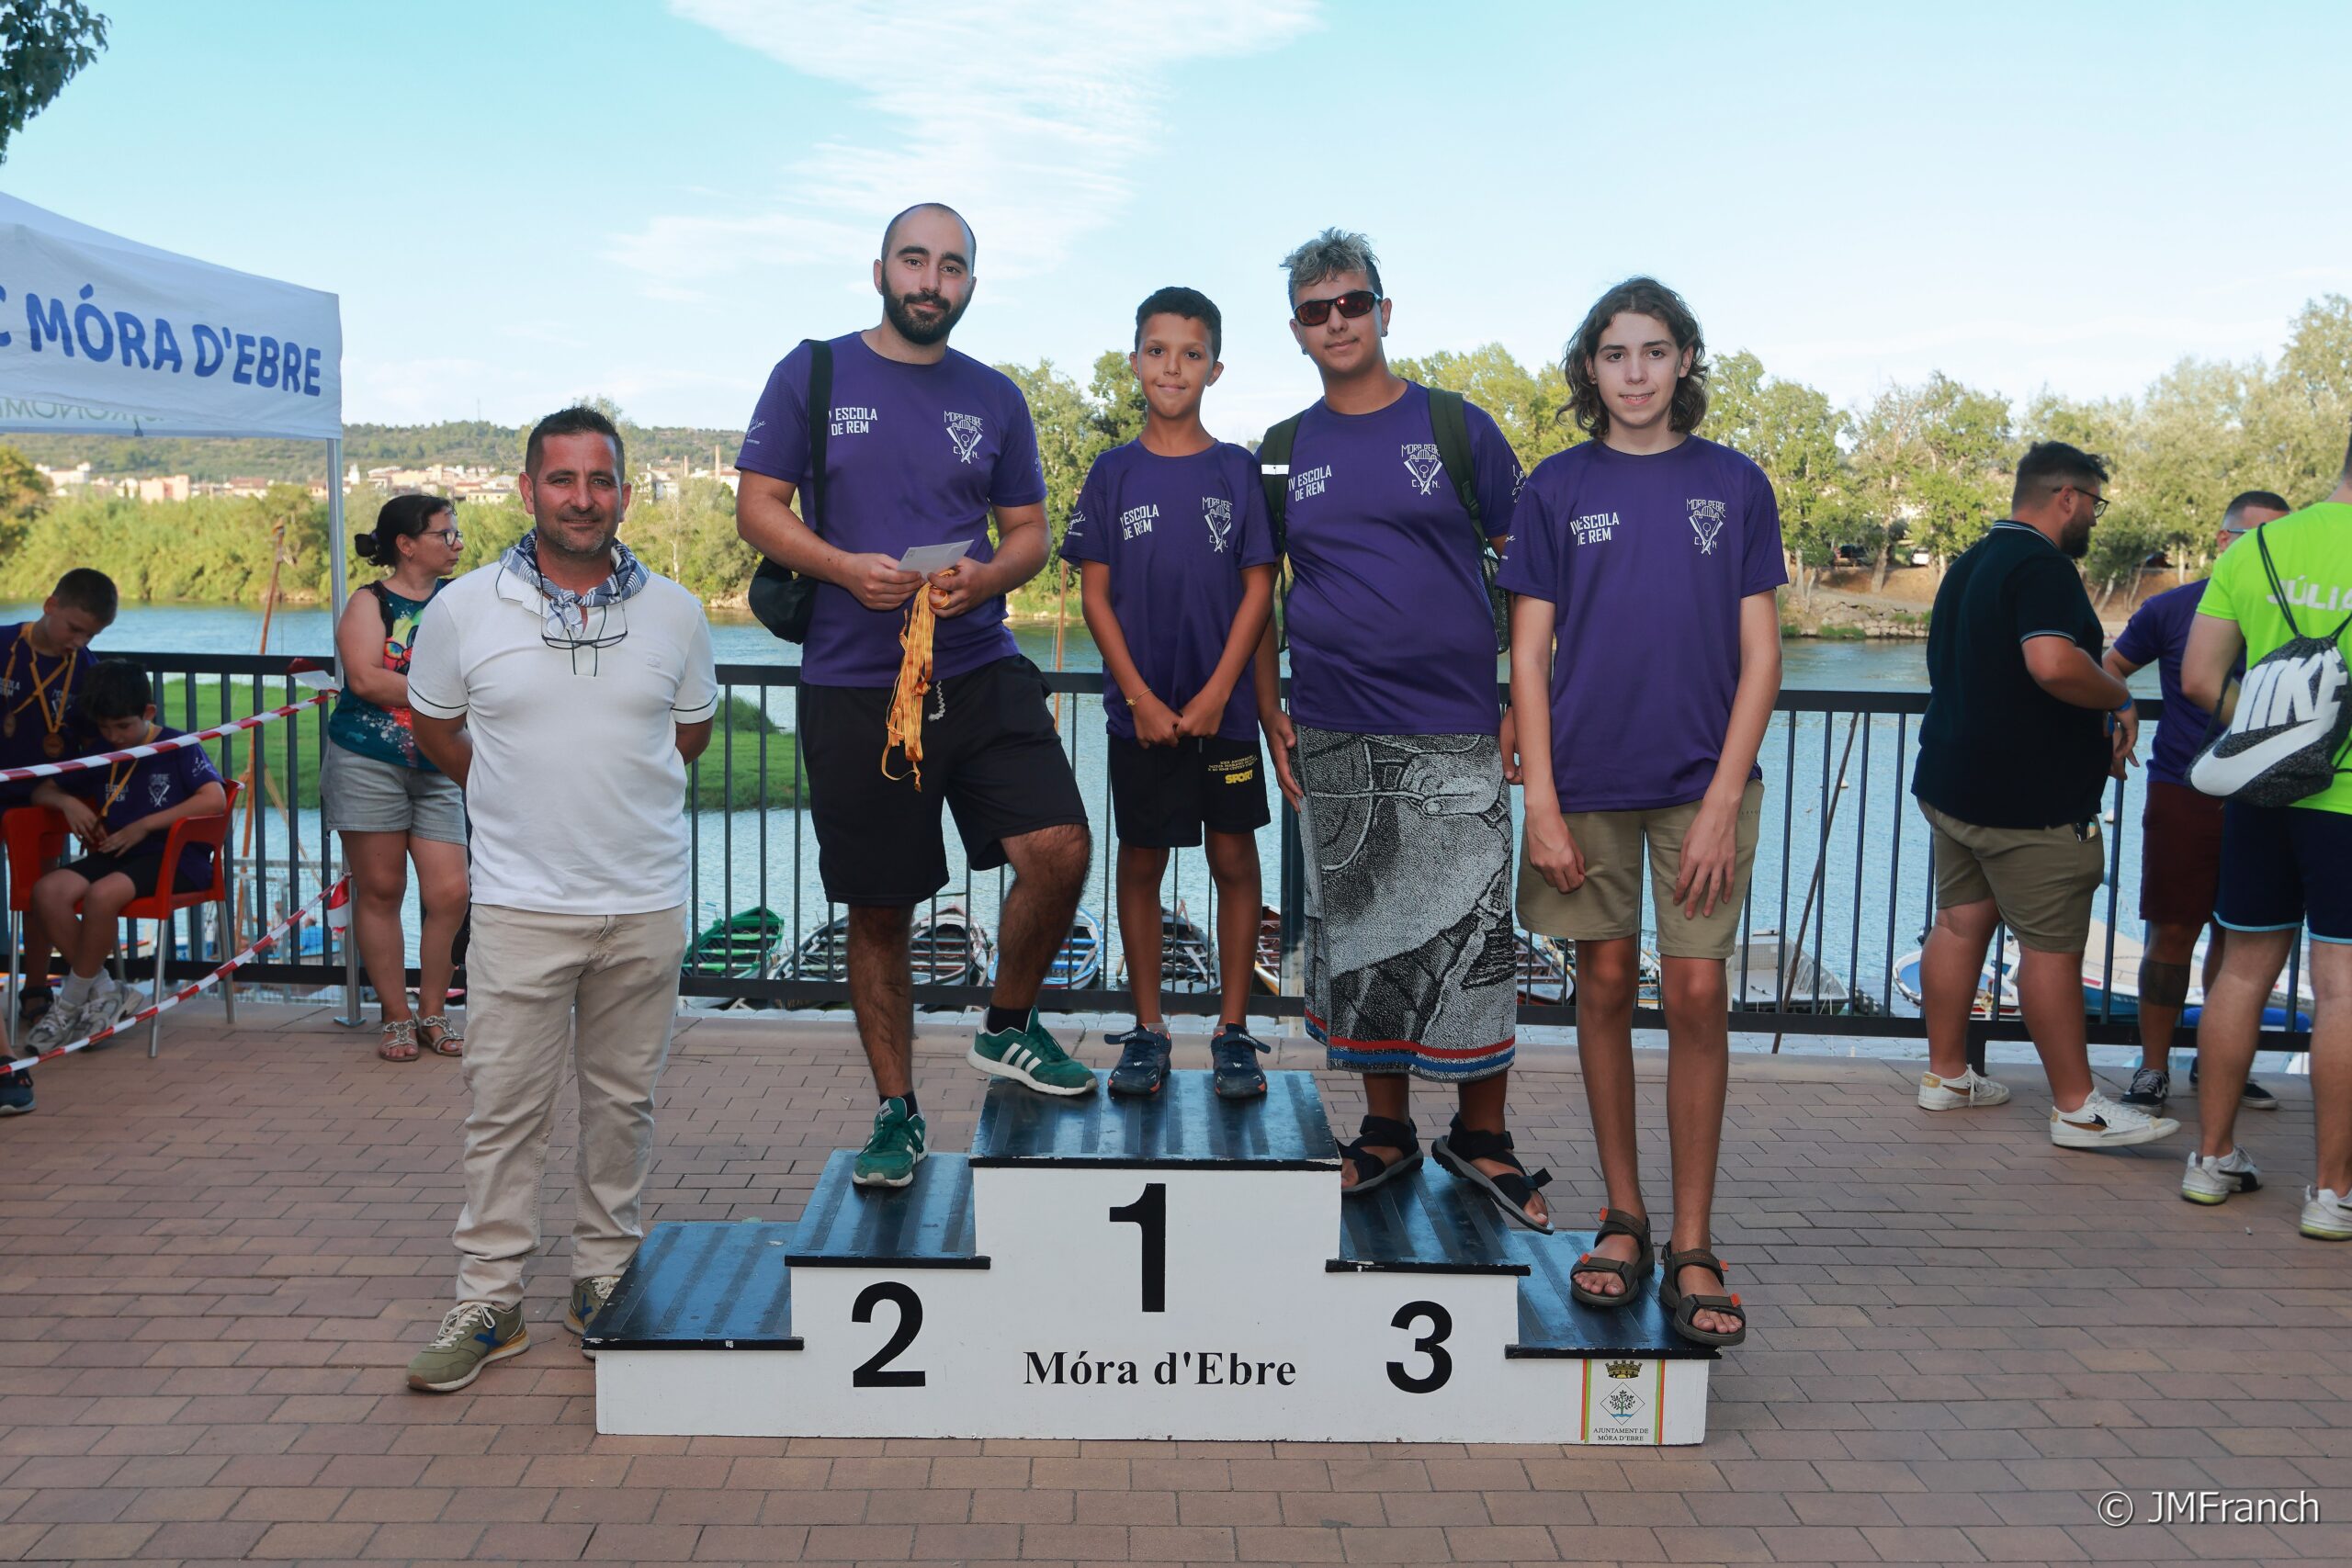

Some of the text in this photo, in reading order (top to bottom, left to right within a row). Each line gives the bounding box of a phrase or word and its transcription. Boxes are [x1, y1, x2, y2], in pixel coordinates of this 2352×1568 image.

[26, 284, 183, 373] MÓRA
[192, 324, 322, 397] D'EBRE
[831, 420, 869, 436] DE REM
[835, 407, 878, 422] ESCOLA
[1288, 464, 1332, 492] IV ESCOLA
[1295, 479, 1326, 502] DE REM
[1123, 503, 1159, 525] ESCOLA
[1123, 518, 1152, 541] DE REM
[1588, 526, 1611, 544] REM
[2231, 646, 2348, 737] NIKE
[1109, 1182, 1167, 1313] 1
[851, 1280, 926, 1388] 2
[1385, 1300, 1453, 1394] 3
[1023, 1350, 1296, 1386] Móra d'Ebre
